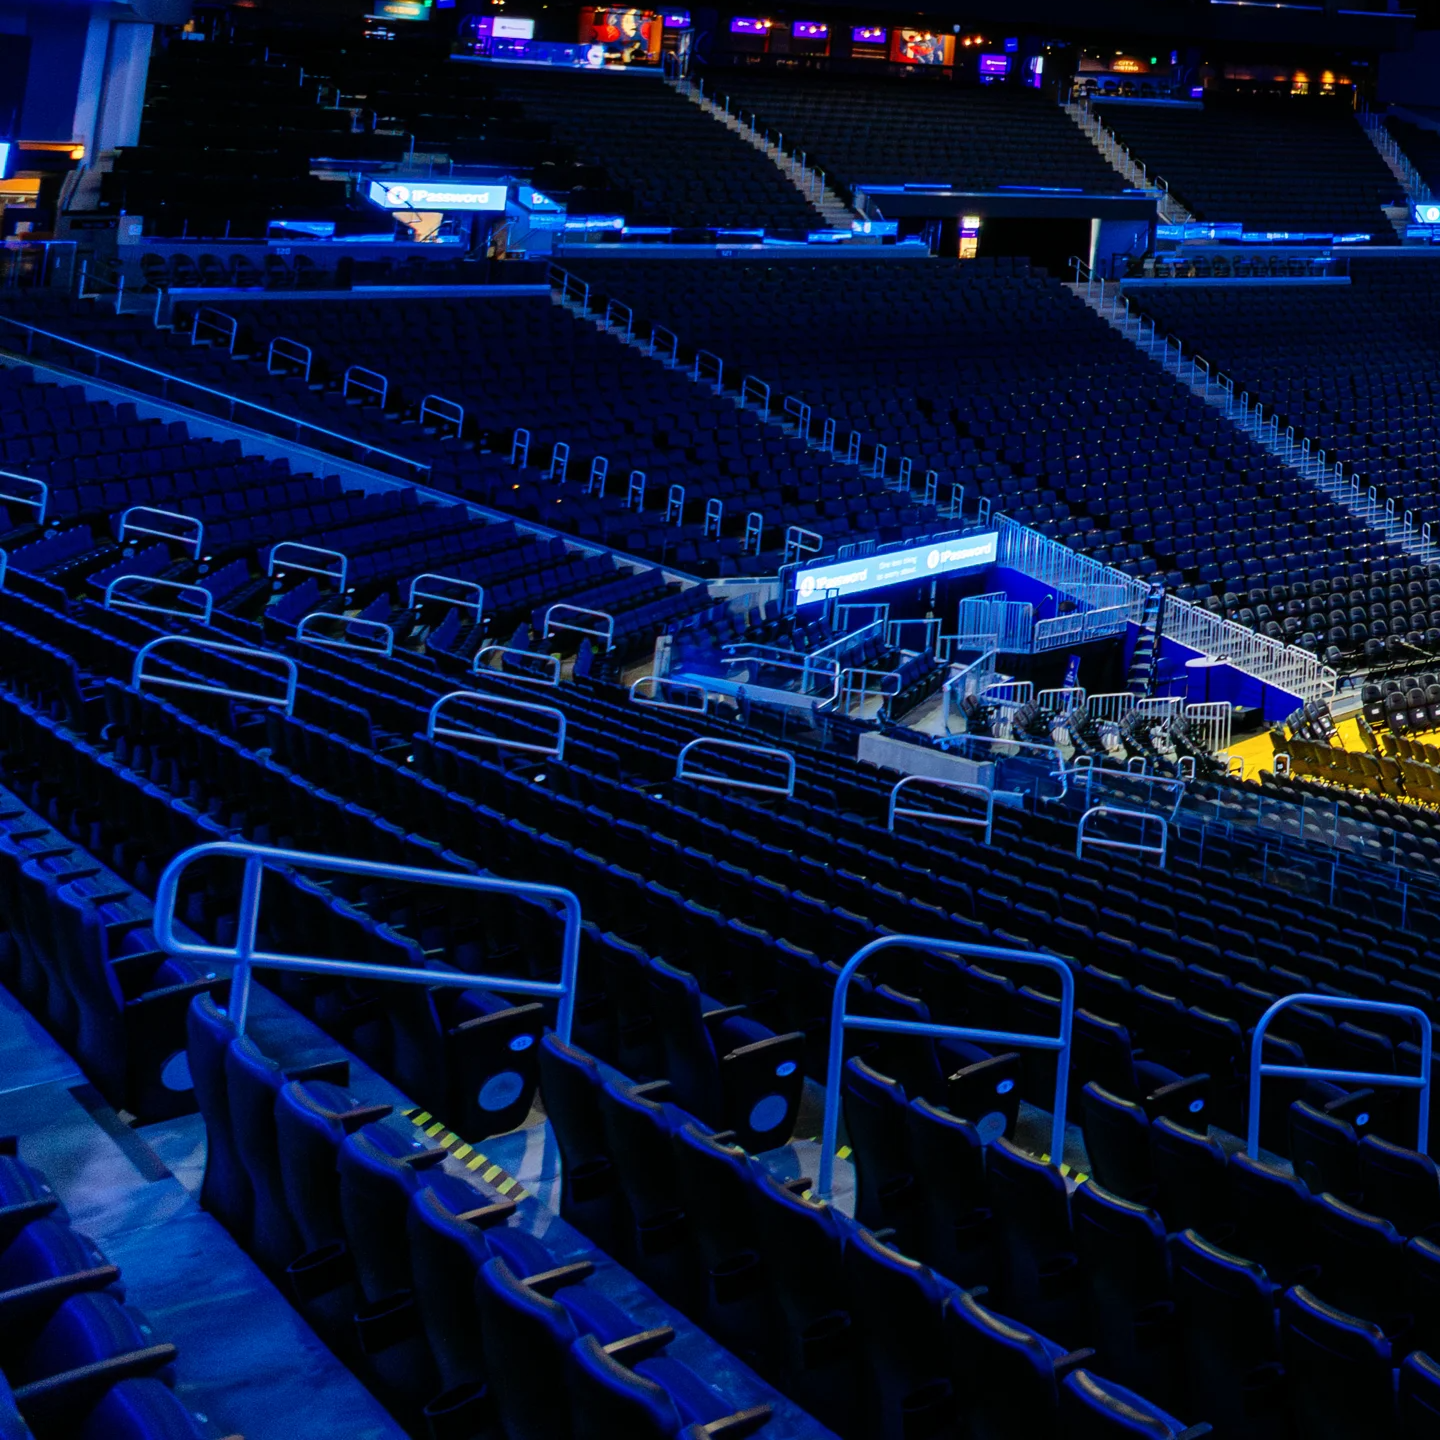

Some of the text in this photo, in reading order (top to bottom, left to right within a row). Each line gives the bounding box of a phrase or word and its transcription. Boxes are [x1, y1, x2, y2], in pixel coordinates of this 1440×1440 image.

[411, 189, 490, 205] 1Password
[940, 541, 992, 564] 1Password
[815, 568, 869, 590] 1Password
